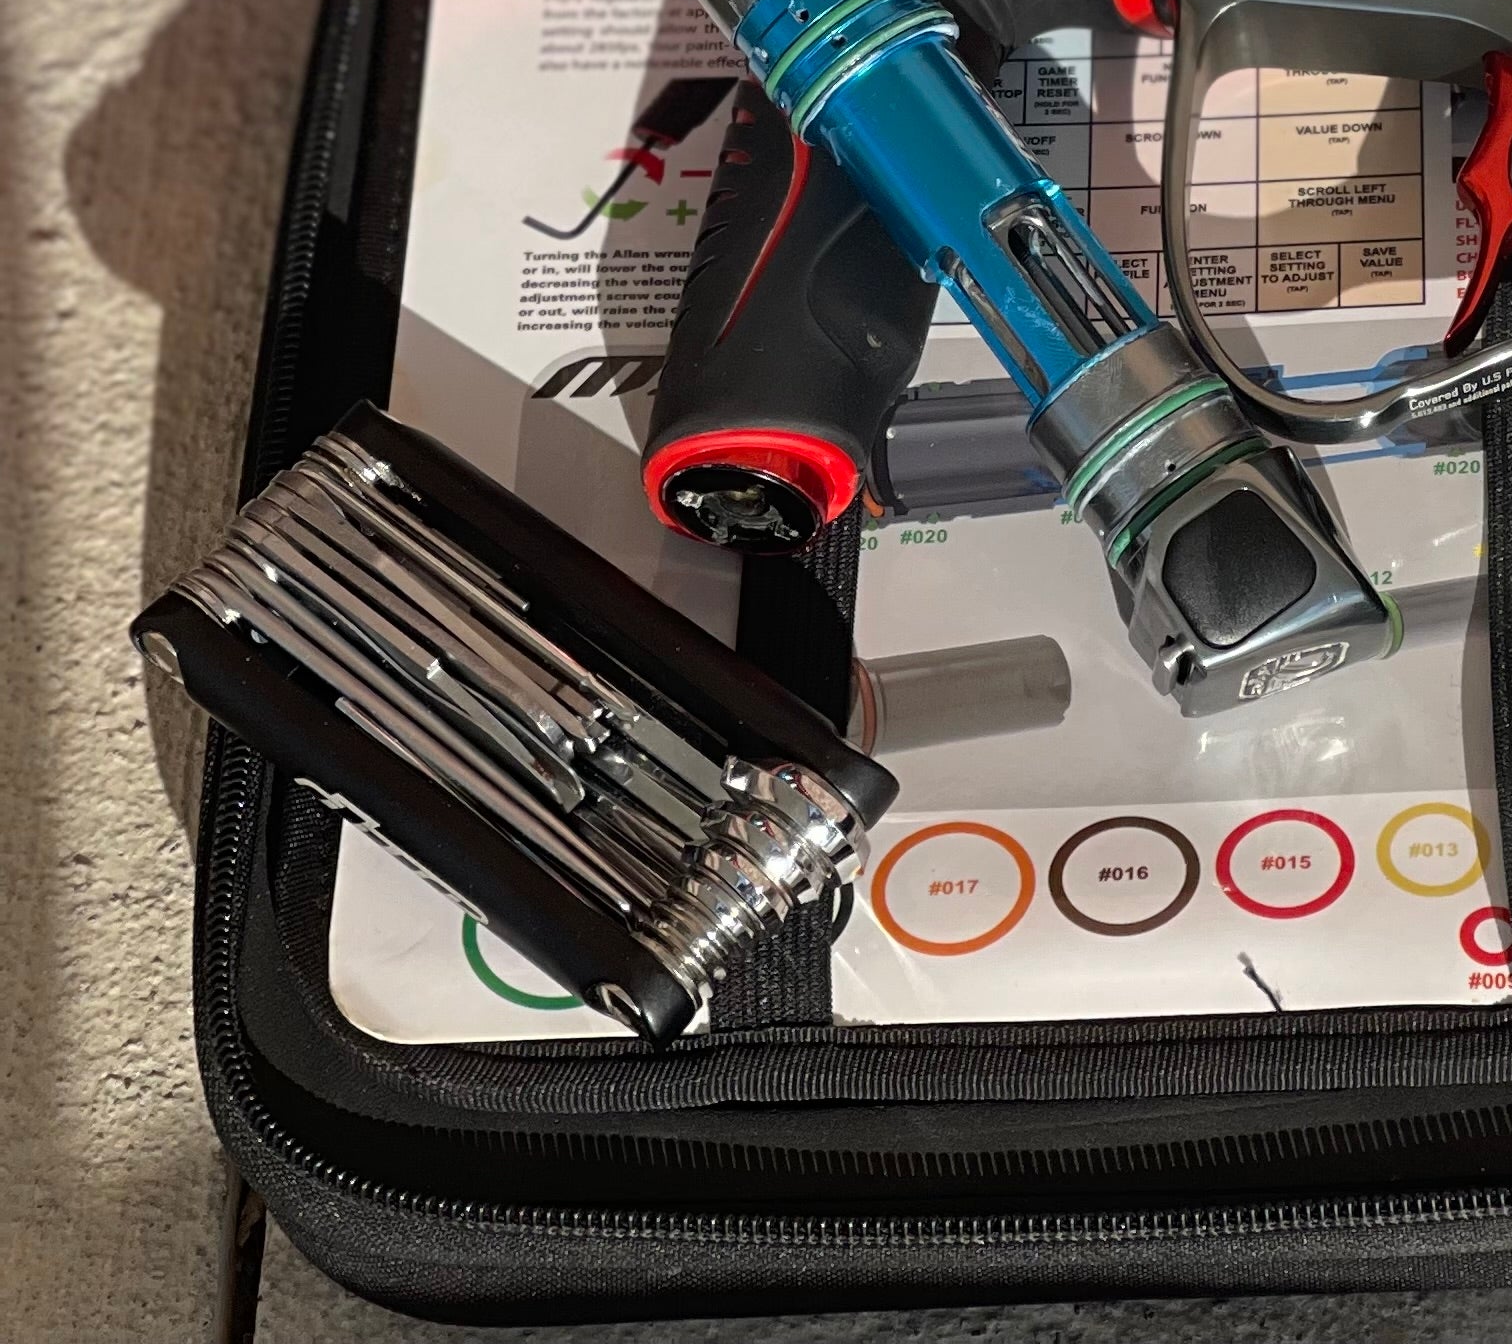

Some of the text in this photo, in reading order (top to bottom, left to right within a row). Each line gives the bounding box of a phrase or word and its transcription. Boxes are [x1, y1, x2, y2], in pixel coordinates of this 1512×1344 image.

[1038, 66, 1076, 76] GAME
[1038, 78, 1078, 87] TIMER
[1037, 88, 1079, 98] RESET
[1296, 122, 1383, 135] VALUE DOWN
[1298, 184, 1387, 196] SCROLL LEFT
[1288, 195, 1395, 208] THROUGH MENU
[523, 252, 579, 262] Turning
[584, 250, 607, 259] the
[612, 249, 649, 258] Allen
[1271, 250, 1321, 261] SELECT
[1363, 247, 1397, 256] SAVE
[1270, 261, 1326, 272] SETTING
[1360, 257, 1404, 268] VALUE
[522, 267, 537, 275] or
[542, 265, 560, 275] in,
[565, 264, 591, 273] will
[596, 263, 636, 272] lower
[641, 263, 664, 272] the
[521, 278, 600, 289] decreasing
[605, 277, 628, 286] the
[1261, 272, 1335, 283] TO ADJUST
[519, 293, 600, 304] adjustment
[606, 291, 649, 300] screw
[518, 308, 533, 317] or
[538, 307, 566, 316] out,
[572, 305, 599, 315] will
[603, 305, 638, 315] raise
[643, 304, 666, 314] the
[517, 320, 592, 331] increasing
[598, 319, 621, 328] the
[1408, 387, 1459, 411] Covered
[1462, 382, 1478, 394] By
[1448, 398, 1462, 410] and
[1433, 460, 1481, 475] #020
[900, 529, 948, 544] #020
[1408, 842, 1460, 860] #013
[1260, 855, 1312, 871] #015
[1098, 865, 1149, 884] #016
[928, 879, 979, 897] #017
